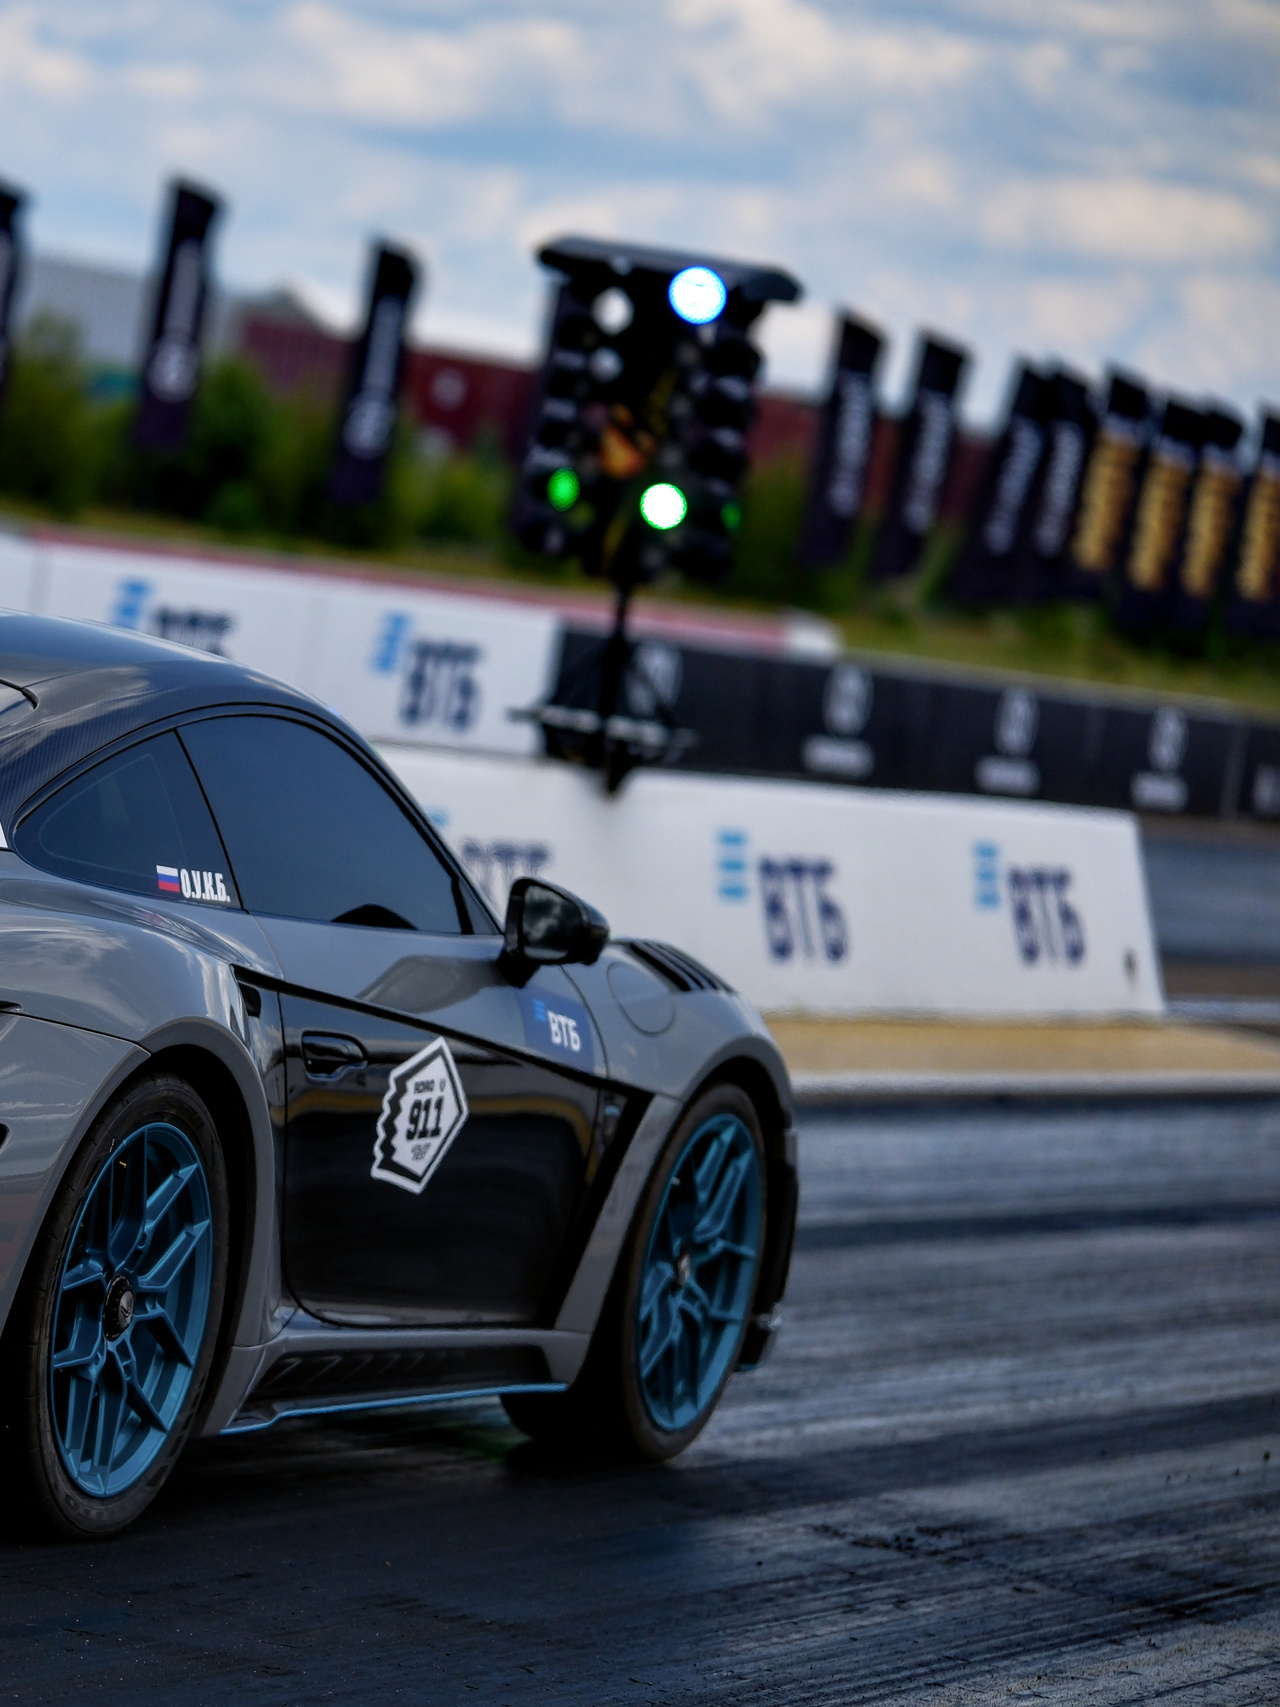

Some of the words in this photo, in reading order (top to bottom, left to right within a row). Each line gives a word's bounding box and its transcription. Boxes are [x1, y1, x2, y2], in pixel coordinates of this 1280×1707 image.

[403, 640, 480, 731] ВТБ
[760, 857, 847, 963] ВТБ
[1009, 866, 1085, 966] ВТБ
[547, 1009, 581, 1052] ВТБ
[406, 1096, 445, 1141] 911
